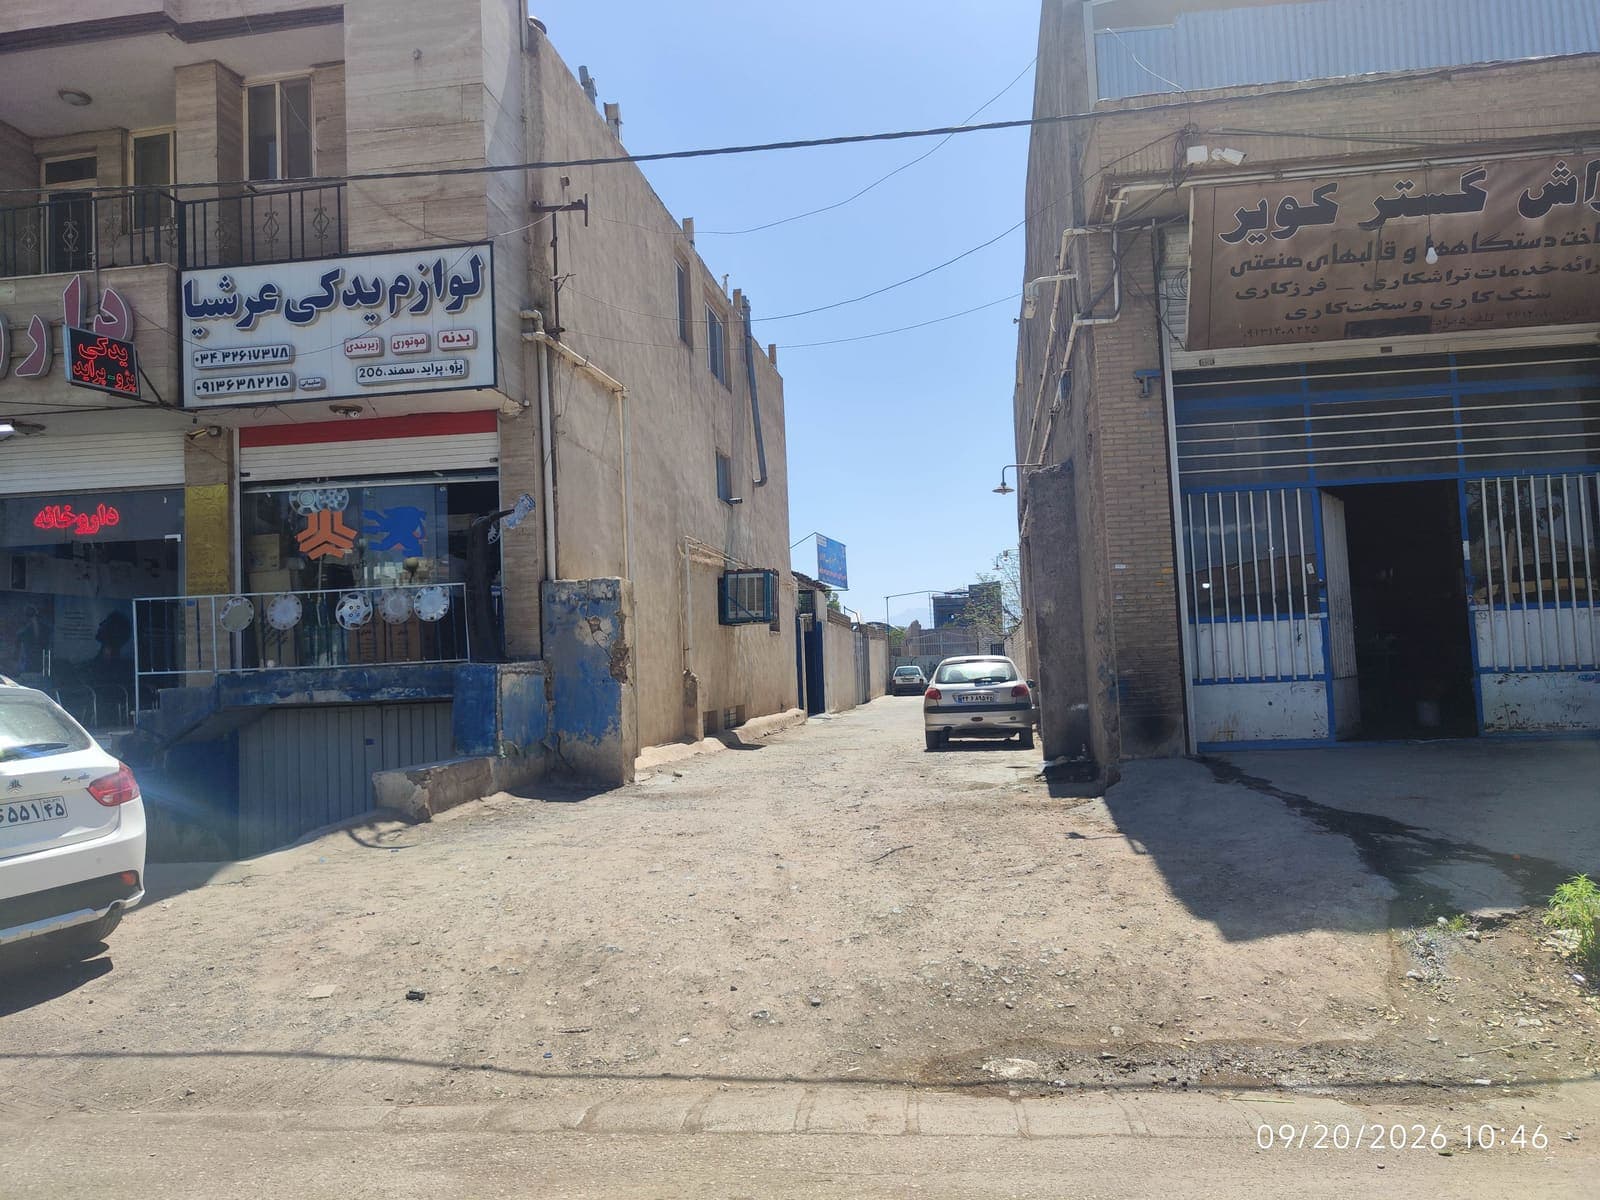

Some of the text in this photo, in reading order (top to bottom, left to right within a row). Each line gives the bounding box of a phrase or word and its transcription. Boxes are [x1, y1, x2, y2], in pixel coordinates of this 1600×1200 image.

[1358, 165, 1488, 231] گستر
[1218, 182, 1340, 245] کویر
[1230, 252, 1303, 278] صنعتی
[1403, 246, 1417, 265] و
[1474, 261, 1560, 280] خدمات
[183, 253, 483, 336] لوازم یدکی عرشیا
[346, 338, 380, 353] زیربندی
[393, 337, 426, 350] موتوری
[442, 331, 470, 345] بدنه
[78, 337, 129, 368] یدکی
[72, 360, 107, 387] پراید
[115, 369, 137, 392] پژو
[360, 367, 382, 378] 206
[197, 375, 289, 392] ۰۹۱۳۶۳۸۲۲۱۵
[33, 503, 120, 535] داروخانه
[44, 803, 65, 818] ۴۵
